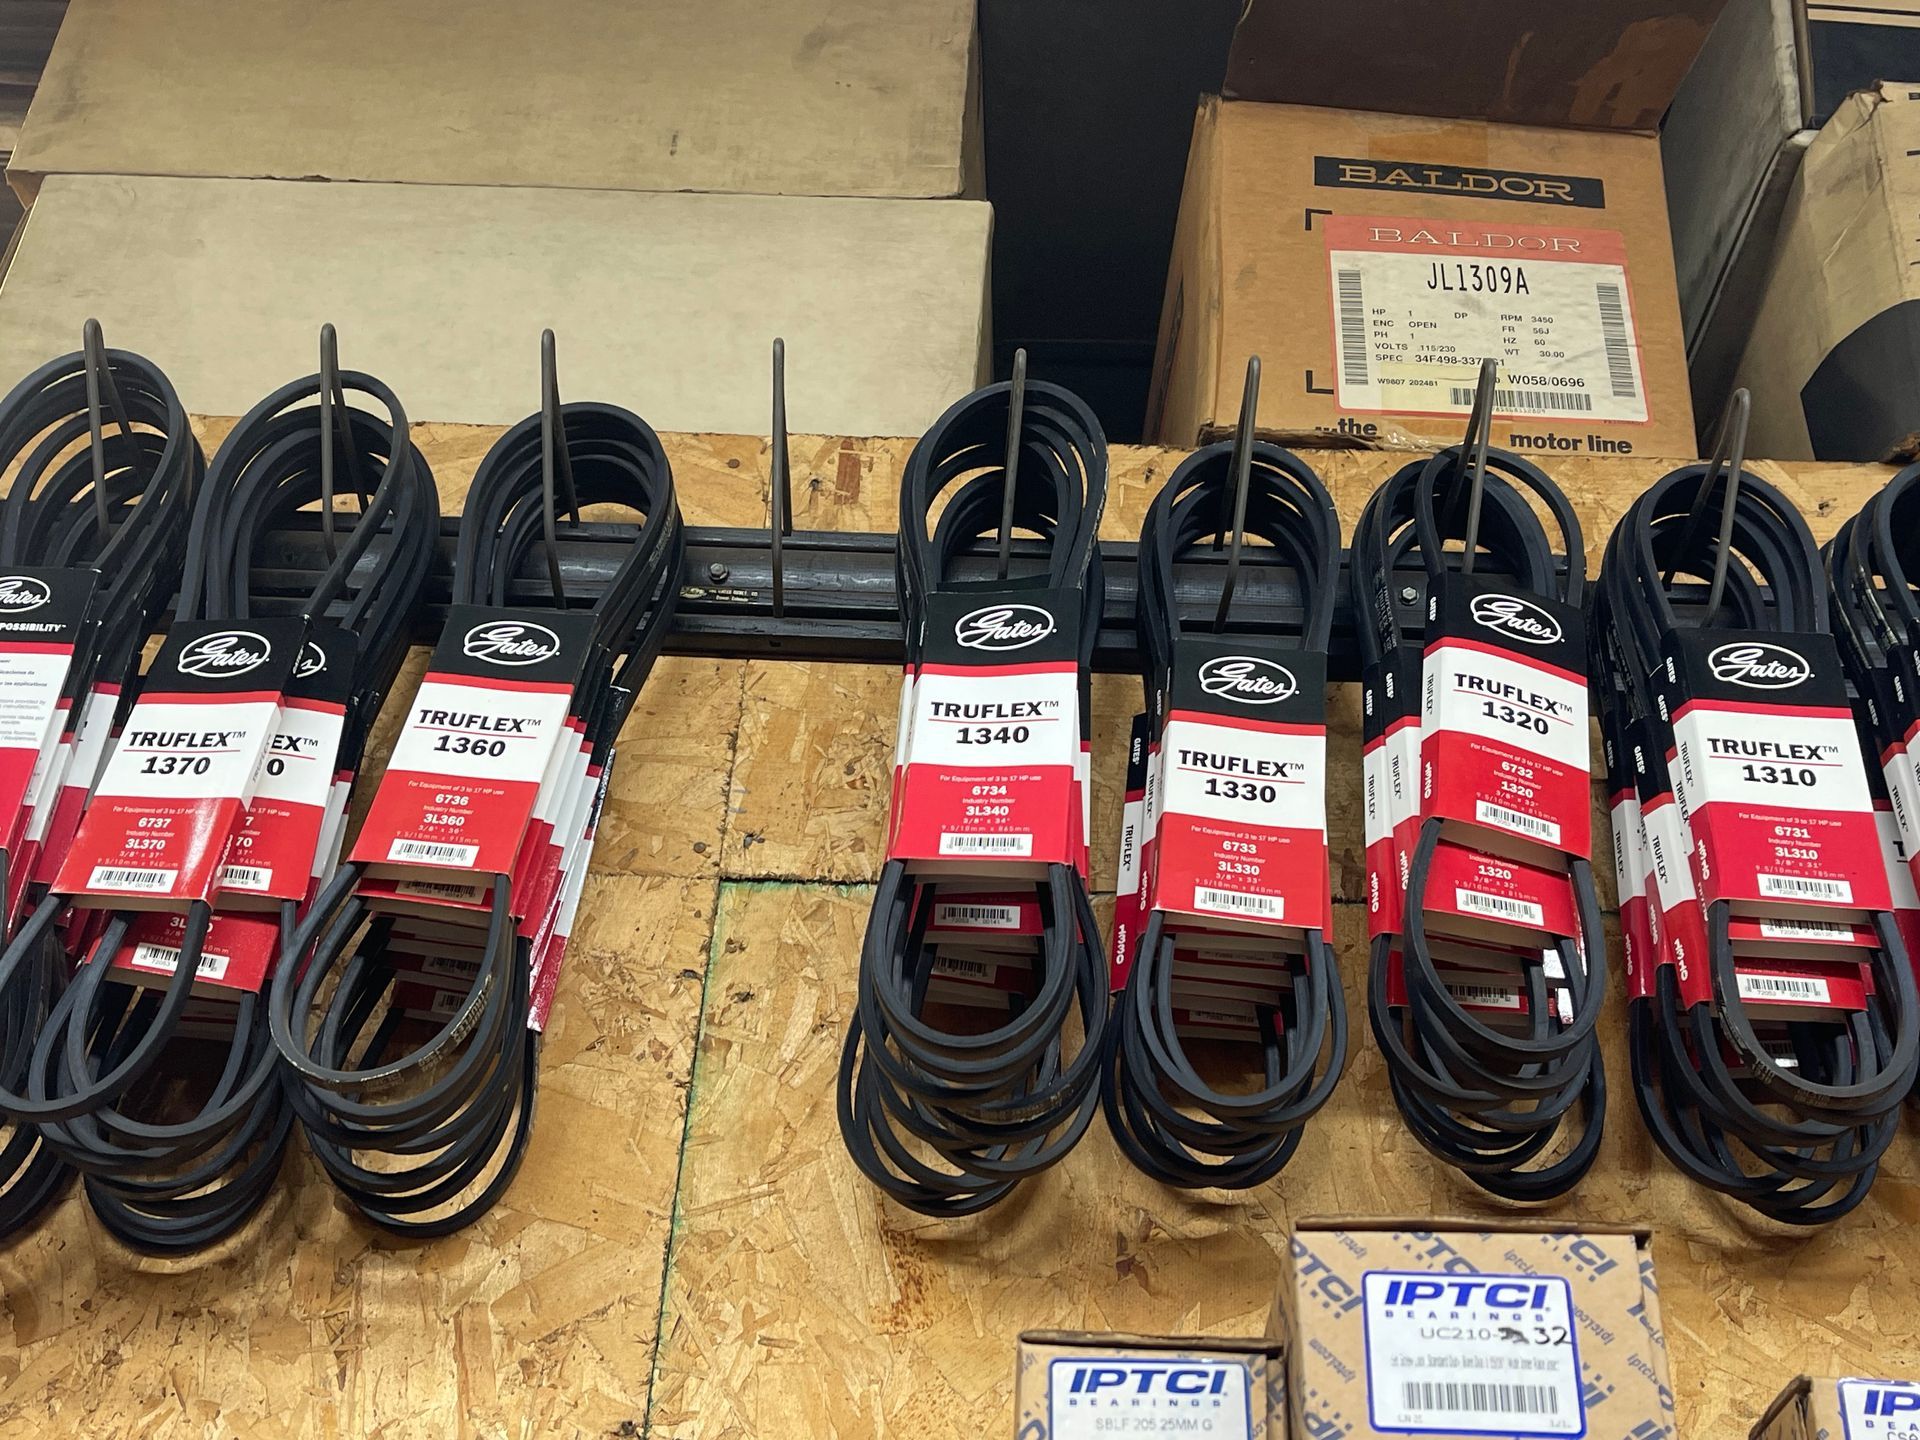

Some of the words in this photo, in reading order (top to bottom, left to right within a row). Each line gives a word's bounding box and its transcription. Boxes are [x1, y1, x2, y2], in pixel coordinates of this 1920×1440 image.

[1338, 164, 1575, 202] BALDOR
[1368, 226, 1582, 255] BALDOR
[1427, 263, 1531, 295] JL1309A
[1372, 308, 1386, 316] HP
[1454, 312, 1468, 320] DP
[1501, 314, 1523, 323] RPM
[1531, 316, 1554, 325] 3450
[1373, 320, 1395, 328] ENC
[1408, 321, 1437, 330] OPEN
[1502, 326, 1516, 334] FR
[1374, 331, 1388, 339] PH
[1503, 337, 1517, 345] HZ
[1374, 342, 1409, 352] VOLTS
[1420, 345, 1456, 354] 115/230
[1504, 349, 1520, 357] WT
[1539, 350, 1565, 360] 30.00
[1375, 354, 1404, 363] SPEC
[1507, 373, 1585, 392] W058/0696
[1510, 433, 1582, 455] motor
[1587, 435, 1633, 459] line
[1482, 700, 1549, 735] 1320
[955, 725, 1030, 745] 1340
[433, 734, 506, 757] 1360
[1470, 742, 1481, 750] For
[1481, 745, 1514, 759] Equipment
[140, 756, 211, 775] 1370
[1501, 760, 1534, 779] 6732
[951, 775, 986, 783] Equipment
[1493, 769, 1518, 783] Industry
[1518, 778, 1542, 790] Number
[1742, 764, 1817, 787] 1310
[420, 782, 452, 791] Equipment
[971, 785, 1008, 796] 6734
[1204, 778, 1277, 803] 1330
[1500, 780, 1534, 798] 1320
[434, 793, 470, 806] 6736
[123, 806, 156, 815] Equipment
[423, 805, 449, 813] Industry
[965, 805, 1010, 816] 3L340
[137, 817, 172, 829] 6737
[423, 813, 465, 826] 3L360
[1750, 813, 1785, 822] Equipment
[125, 830, 150, 838] Industry
[1202, 826, 1235, 838] Equipment
[1774, 825, 1811, 839] 6731
[124, 838, 166, 850] 3L370
[1222, 840, 1257, 854] 6733
[1767, 837, 1794, 846] Industry
[1795, 840, 1822, 848] Number
[1213, 851, 1239, 861] Industry
[1240, 855, 1266, 864] Number
[1468, 854, 1494, 866] Industry
[1774, 846, 1818, 860] 3L310
[1218, 860, 1260, 876] 3L330
[1478, 864, 1513, 880] 1320
[1115, 924, 1126, 965] 1330
[1674, 938, 1688, 981] 1310
[1384, 1280, 1549, 1310] IPTCI
[1385, 1310, 1544, 1322] BEARINGS
[1533, 1326, 1572, 1346] 32
[1069, 1367, 1227, 1394] IPTCI
[1069, 1398, 1221, 1407] BEARINGS
[1159, 1419, 1201, 1432] 25MM
